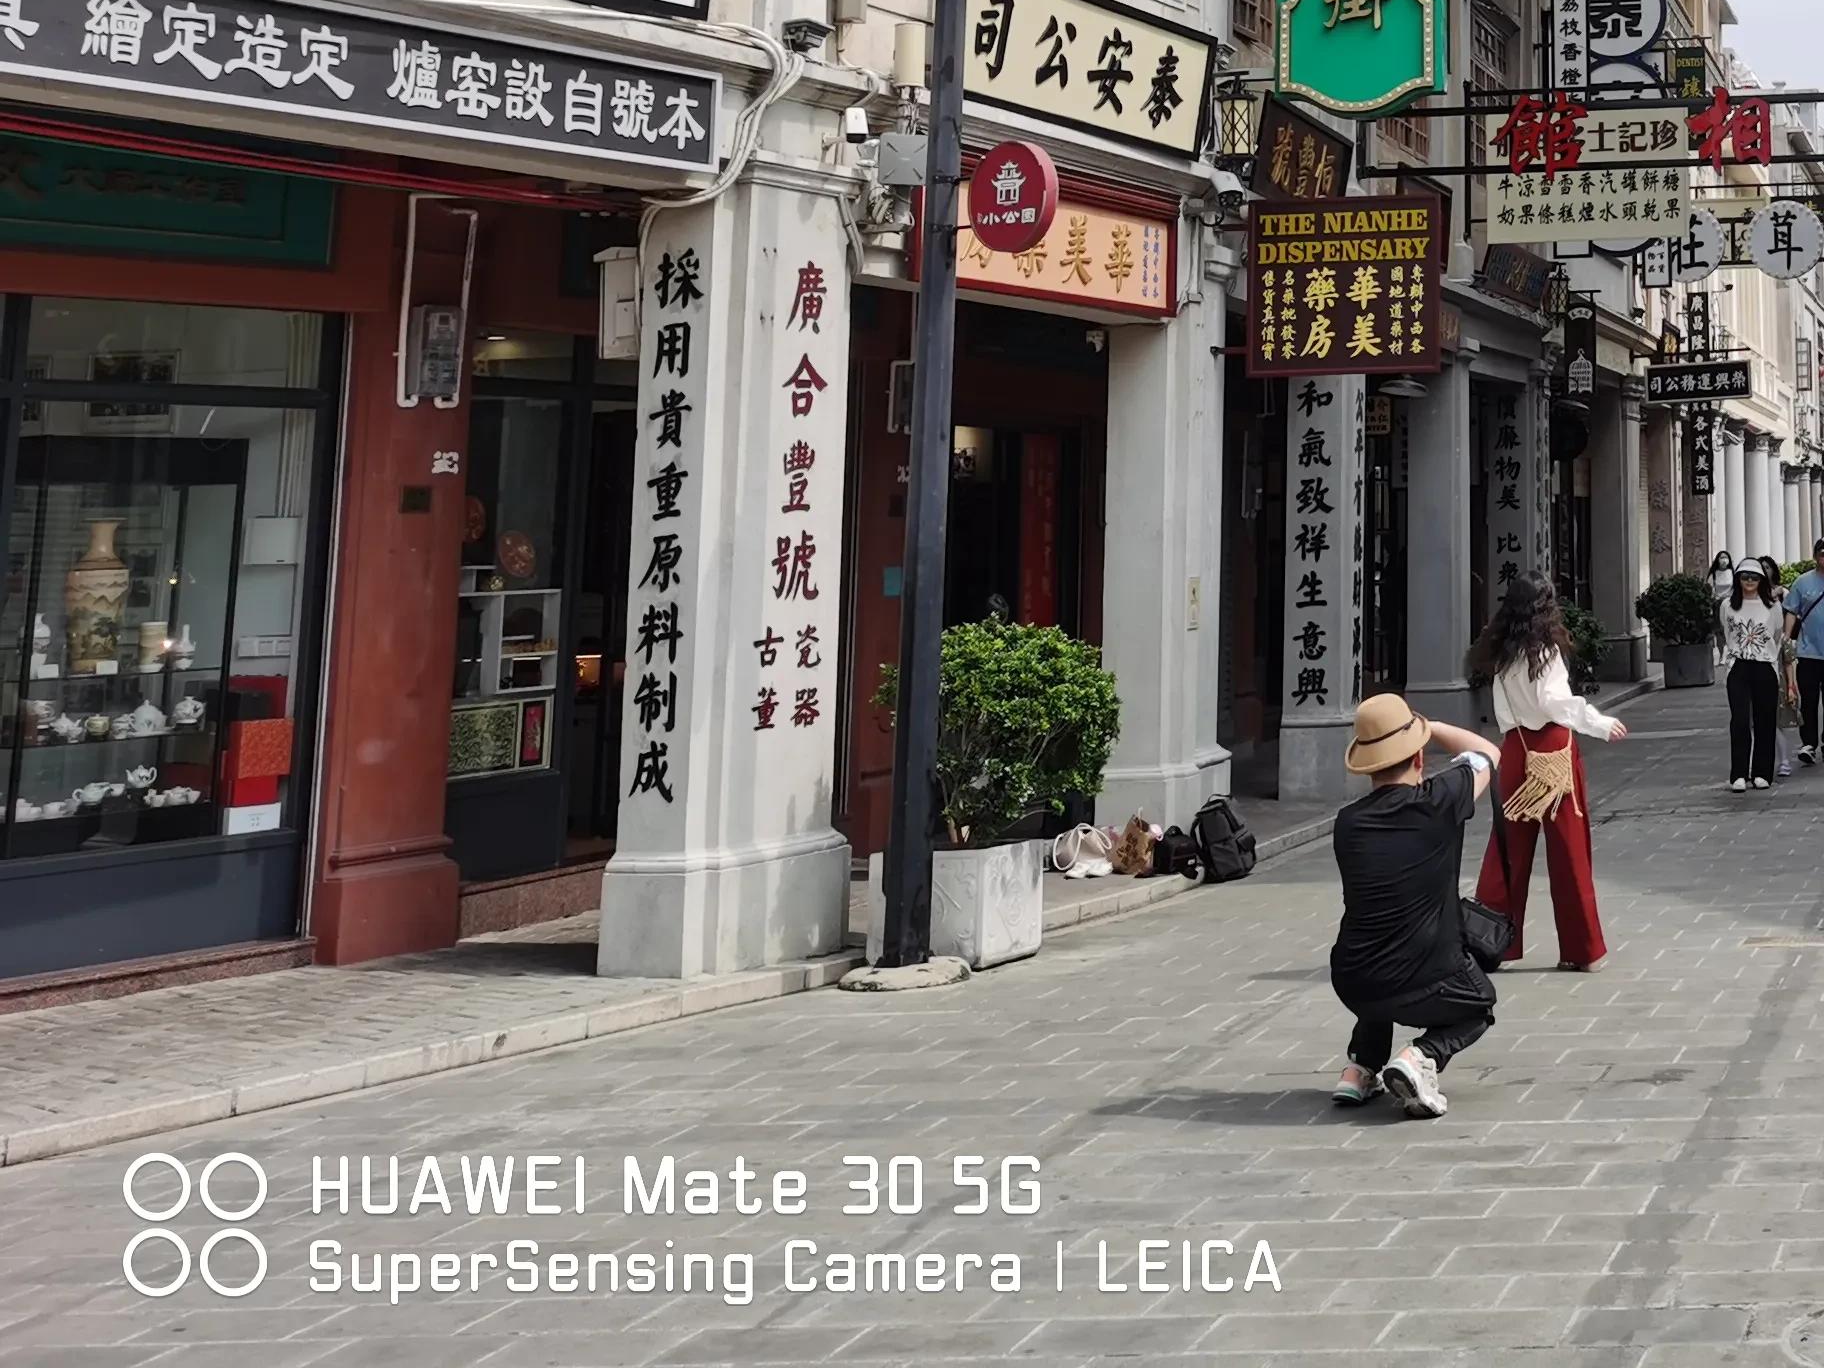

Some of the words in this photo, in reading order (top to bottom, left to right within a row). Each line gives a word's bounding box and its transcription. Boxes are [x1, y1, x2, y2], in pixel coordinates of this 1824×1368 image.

[1257, 237, 1431, 265] DISPENSARY
[1259, 213, 1316, 237] THE
[1322, 208, 1429, 234] NIANHE
[1300, 266, 1341, 360] 藥房
[1345, 264, 1384, 359] 華美
[770, 260, 828, 602] 廣合豐號
[628, 246, 705, 804] 採用貴重原料制成
[1291, 379, 1335, 707] 和氣致祥生意興
[751, 626, 785, 732] 古董
[790, 625, 822, 729] 瓷器
